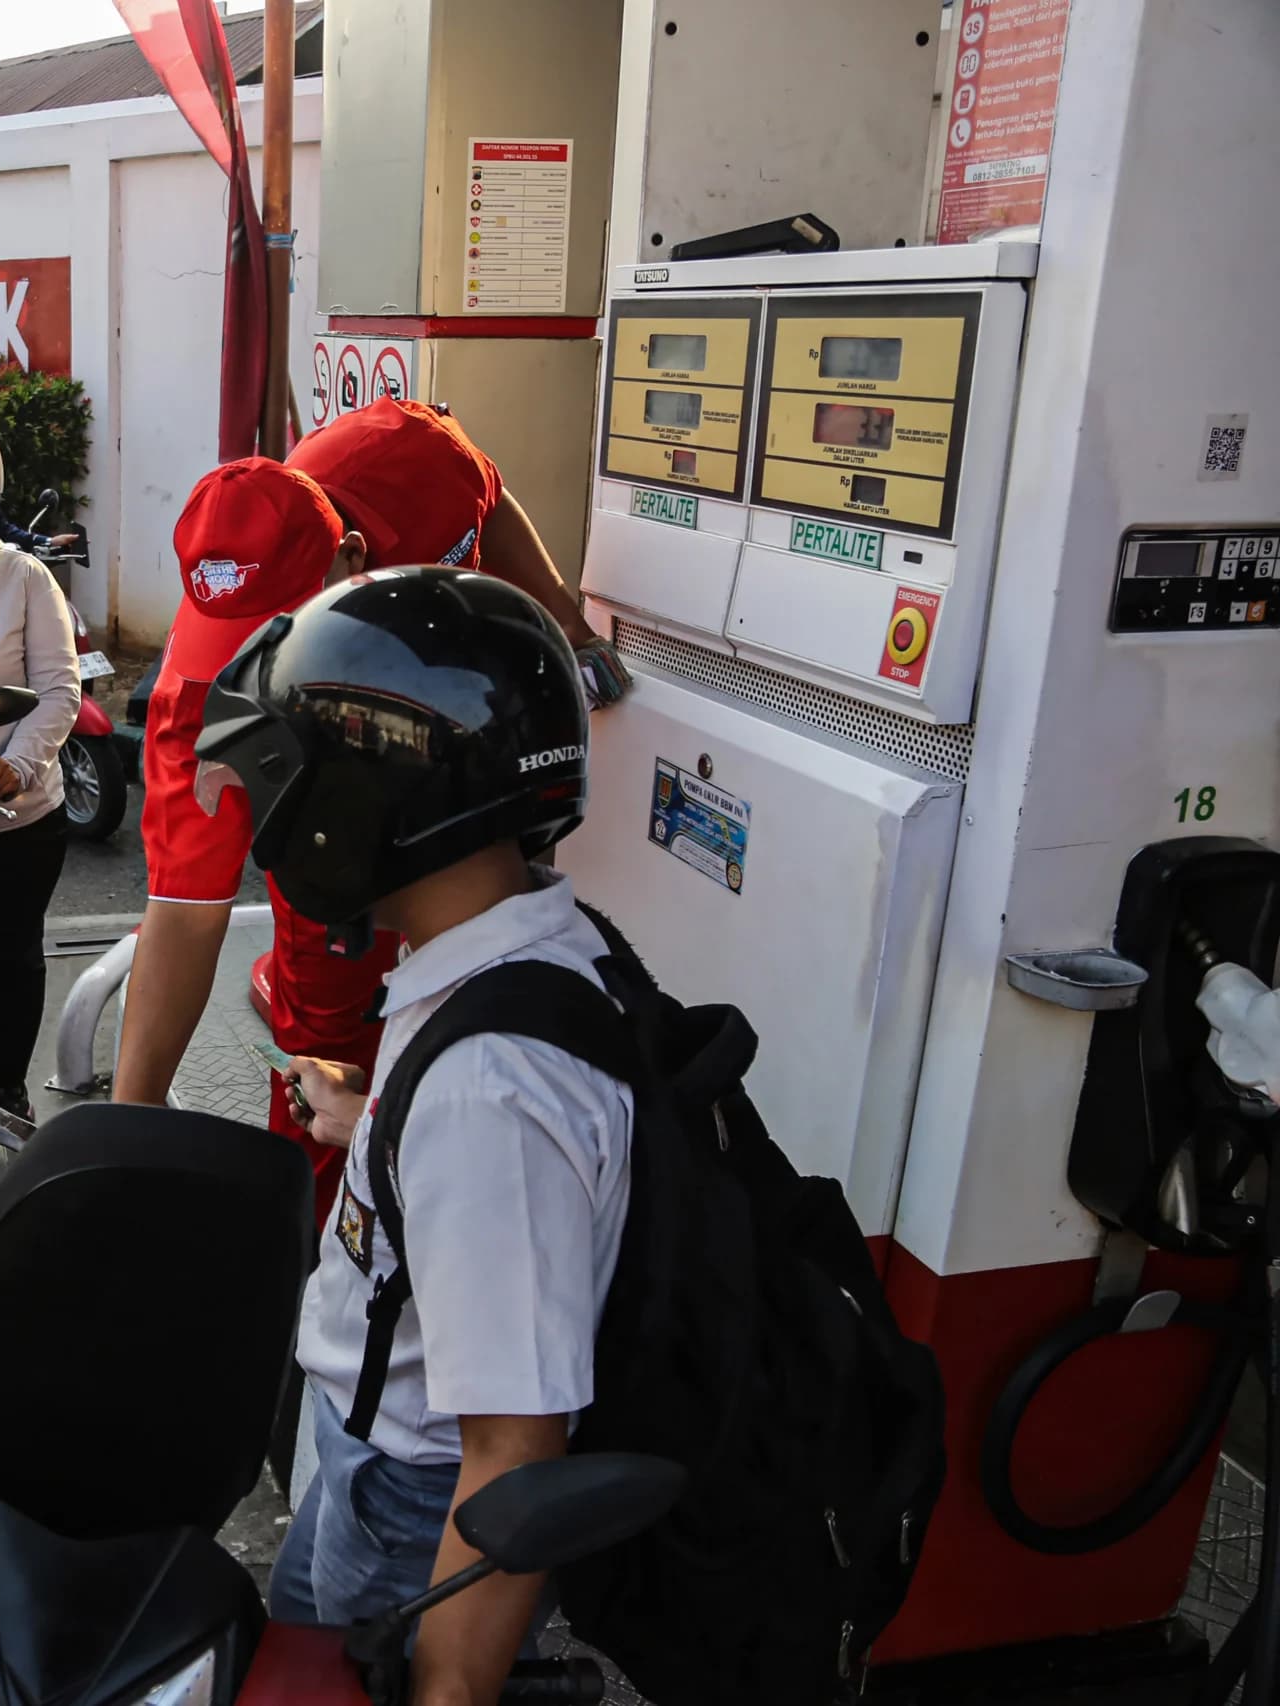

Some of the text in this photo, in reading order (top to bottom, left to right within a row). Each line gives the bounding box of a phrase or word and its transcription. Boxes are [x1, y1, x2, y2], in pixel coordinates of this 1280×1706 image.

[966, 21, 980, 36] 3S
[809, 348, 819, 360] Rp
[664, 450, 672, 460] Rp
[840, 476, 850, 488] Rp
[634, 490, 693, 524] PERTALITE
[794, 522, 878, 562] PERTALITE
[1263, 540, 1272, 554] 9
[1259, 562, 1268, 576] 6
[207, 574, 238, 586] MOVE
[898, 590, 938, 608] EMERGENCY
[1190, 606, 1204, 620] F5
[890, 666, 910, 679] STOP
[518, 744, 586, 773] HONDA
[1172, 785, 1217, 824] 18
